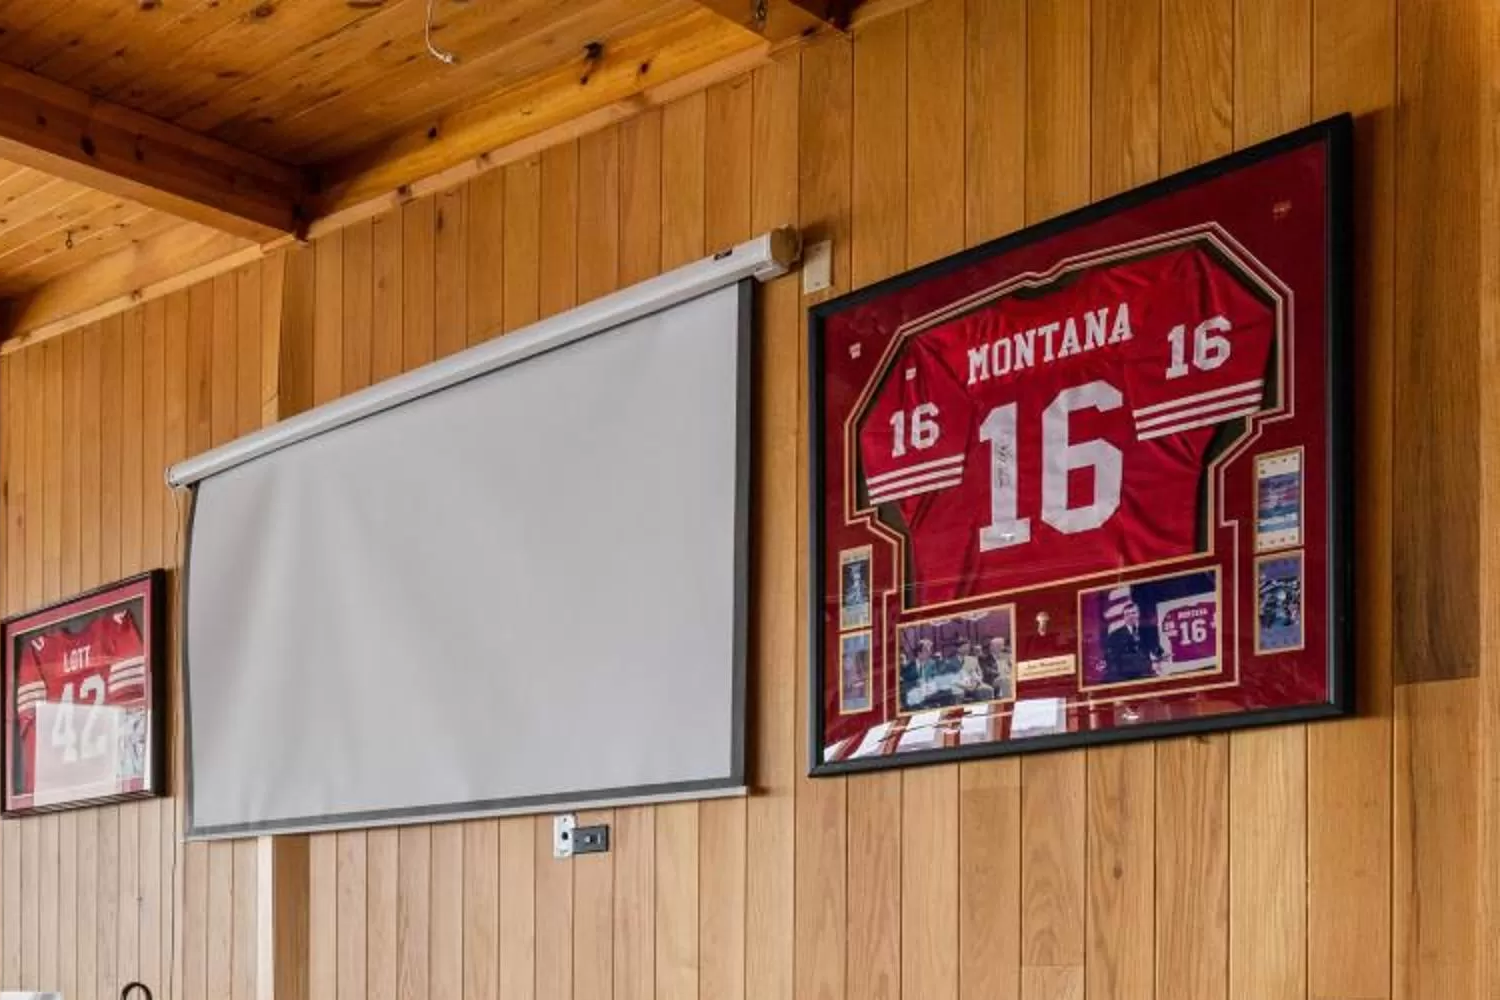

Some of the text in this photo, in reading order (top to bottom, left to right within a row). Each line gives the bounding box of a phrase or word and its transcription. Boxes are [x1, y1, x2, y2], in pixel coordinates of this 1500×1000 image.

[967, 303, 1134, 385] MONTANA
[1165, 315, 1233, 380] 16
[889, 401, 941, 458] 16
[978, 379, 1124, 553] 16
[63, 645, 91, 673] LOTT
[1180, 619, 1207, 645] 16
[52, 674, 106, 762] 42
